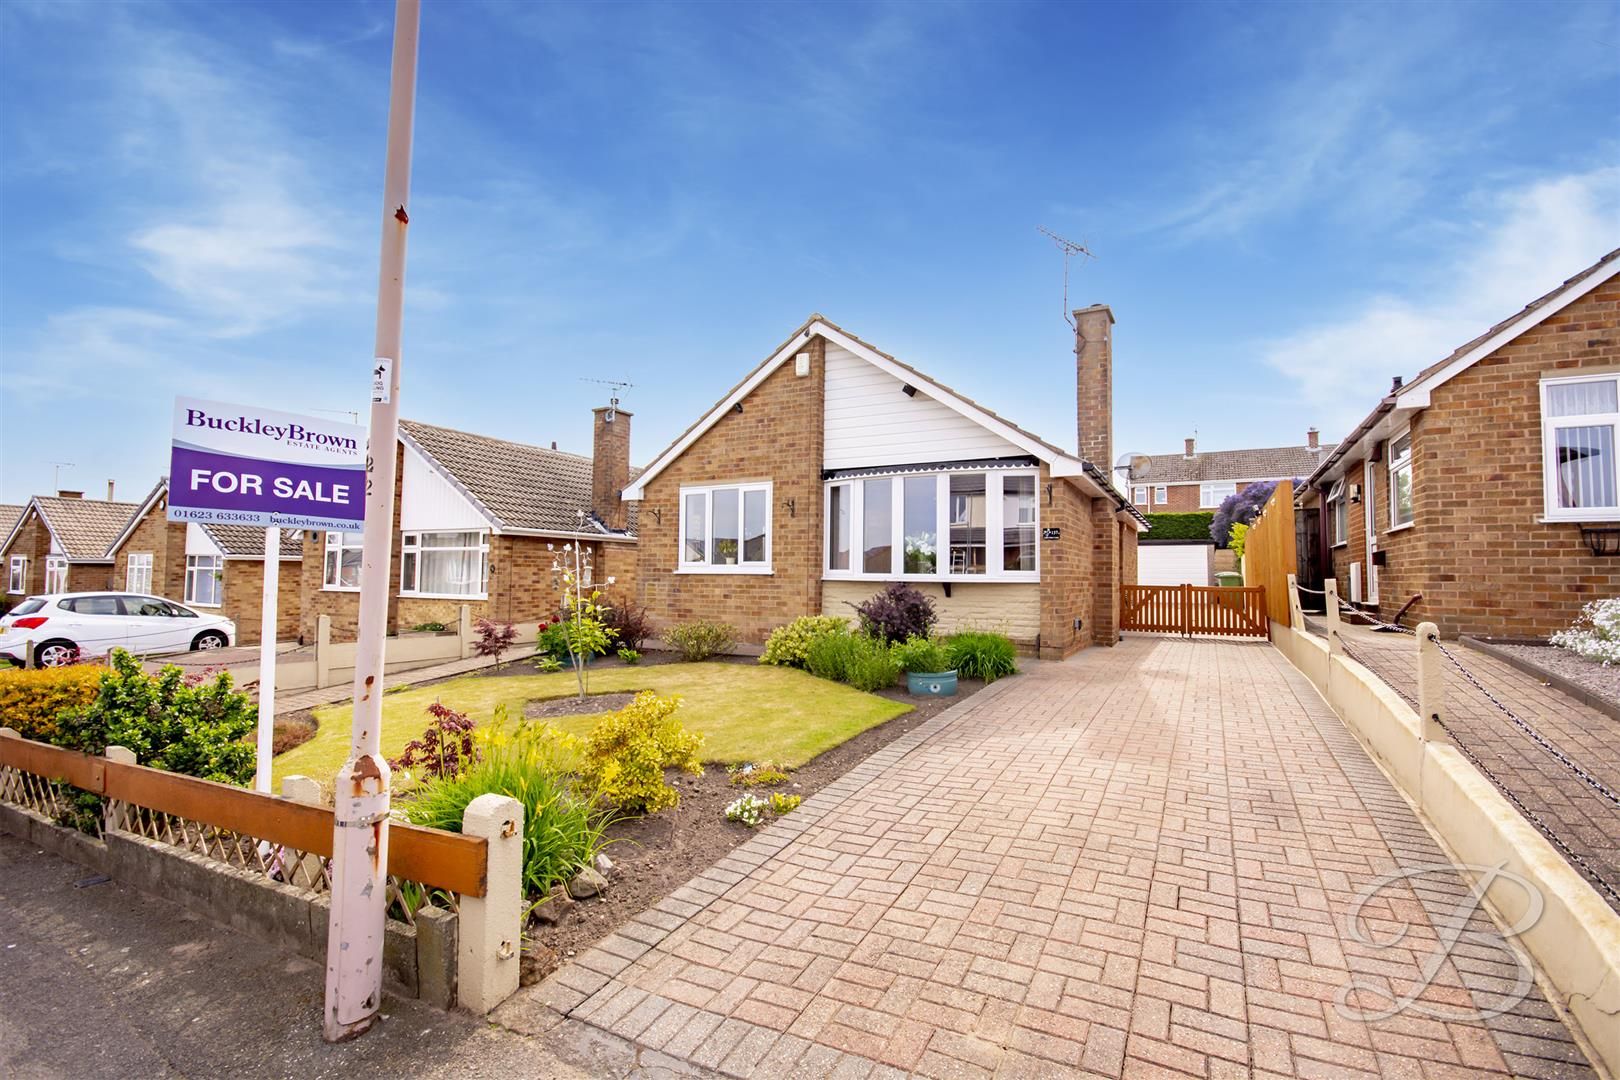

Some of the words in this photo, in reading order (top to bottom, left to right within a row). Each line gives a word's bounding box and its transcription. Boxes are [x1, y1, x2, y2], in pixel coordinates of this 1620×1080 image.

[185, 408, 358, 450] BuckleyBrown
[286, 440, 321, 451] ESTATE
[325, 446, 358, 456] AGENTS
[190, 469, 263, 496] FOR
[272, 477, 350, 505] SALE
[174, 509, 213, 520] 01623
[216, 512, 261, 523] 633633
[269, 515, 361, 530] buckleybrown.co.uk
